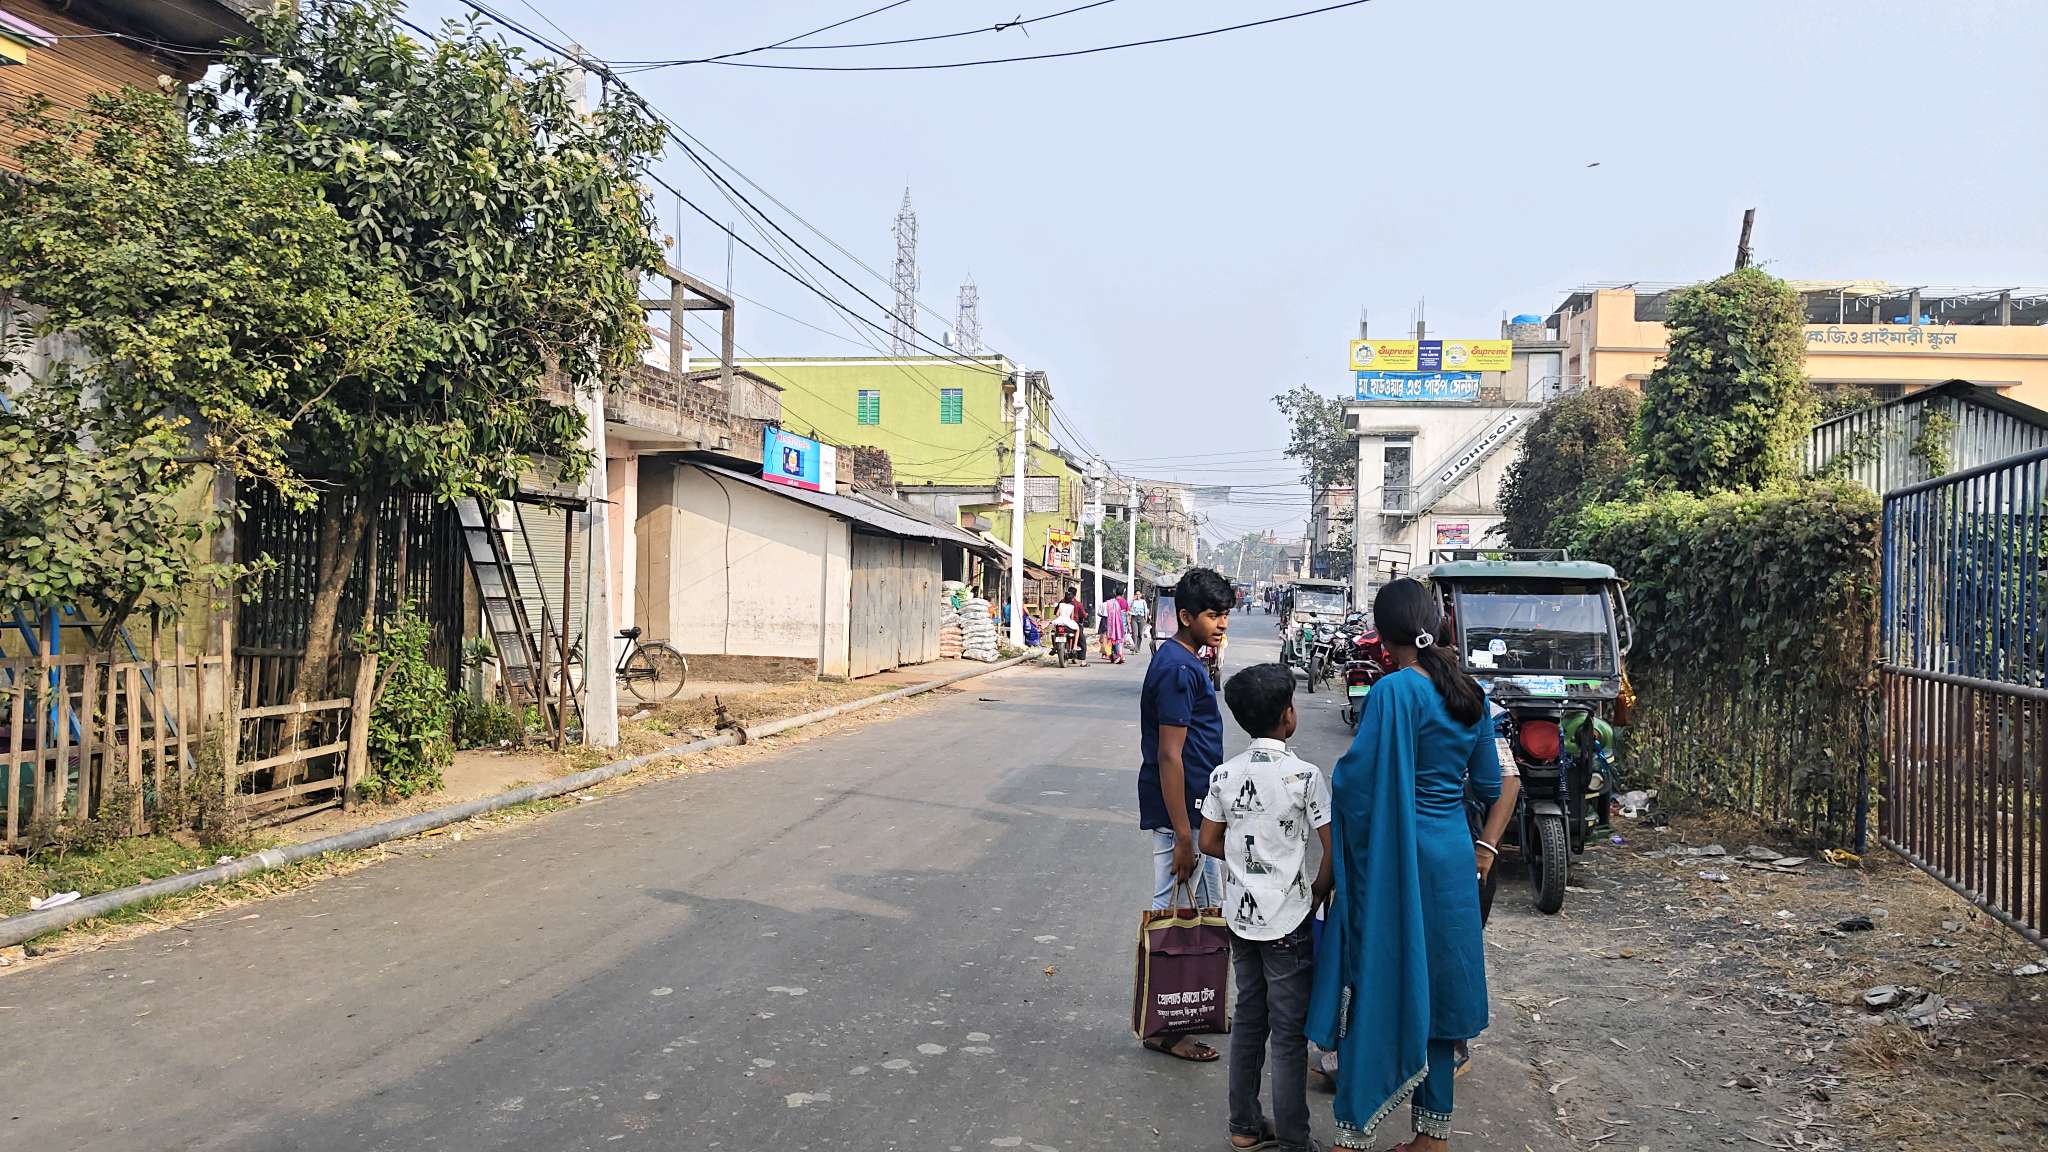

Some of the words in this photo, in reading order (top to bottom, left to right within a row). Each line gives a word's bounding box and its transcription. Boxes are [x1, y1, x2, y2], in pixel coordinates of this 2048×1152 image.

[1860, 327, 1924, 346] প্রাইমারী
[1927, 332, 1957, 349] স্কুল
[1377, 345, 1415, 356] Supreme
[1471, 345, 1508, 356] Supreme
[1358, 378, 1368, 394] মা
[1424, 374, 1448, 397] পাইপ
[1454, 415, 1518, 473] JOHNSON
